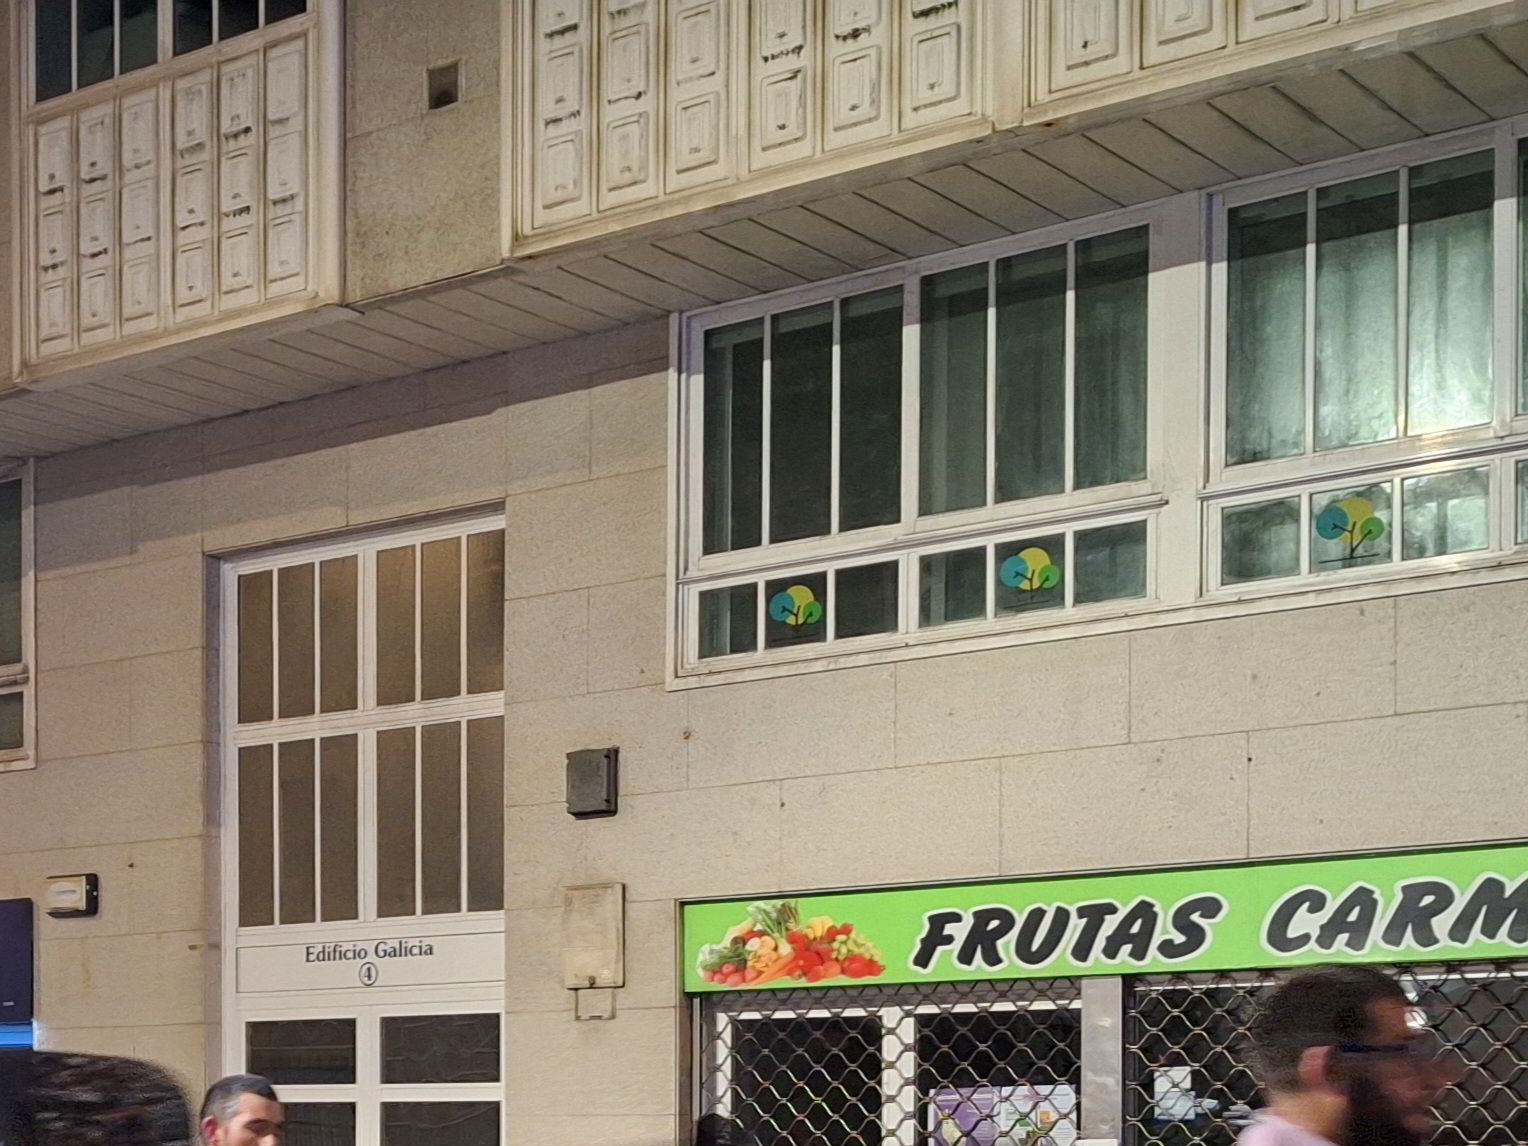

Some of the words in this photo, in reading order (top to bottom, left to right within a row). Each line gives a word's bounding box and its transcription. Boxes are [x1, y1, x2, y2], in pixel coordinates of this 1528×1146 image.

[912, 895, 1225, 969] FRUTAS
[1267, 876, 1528, 954] CARM
[305, 944, 368, 962] Edificio
[374, 940, 434, 958] Galicia
[363, 965, 373, 982] 4
